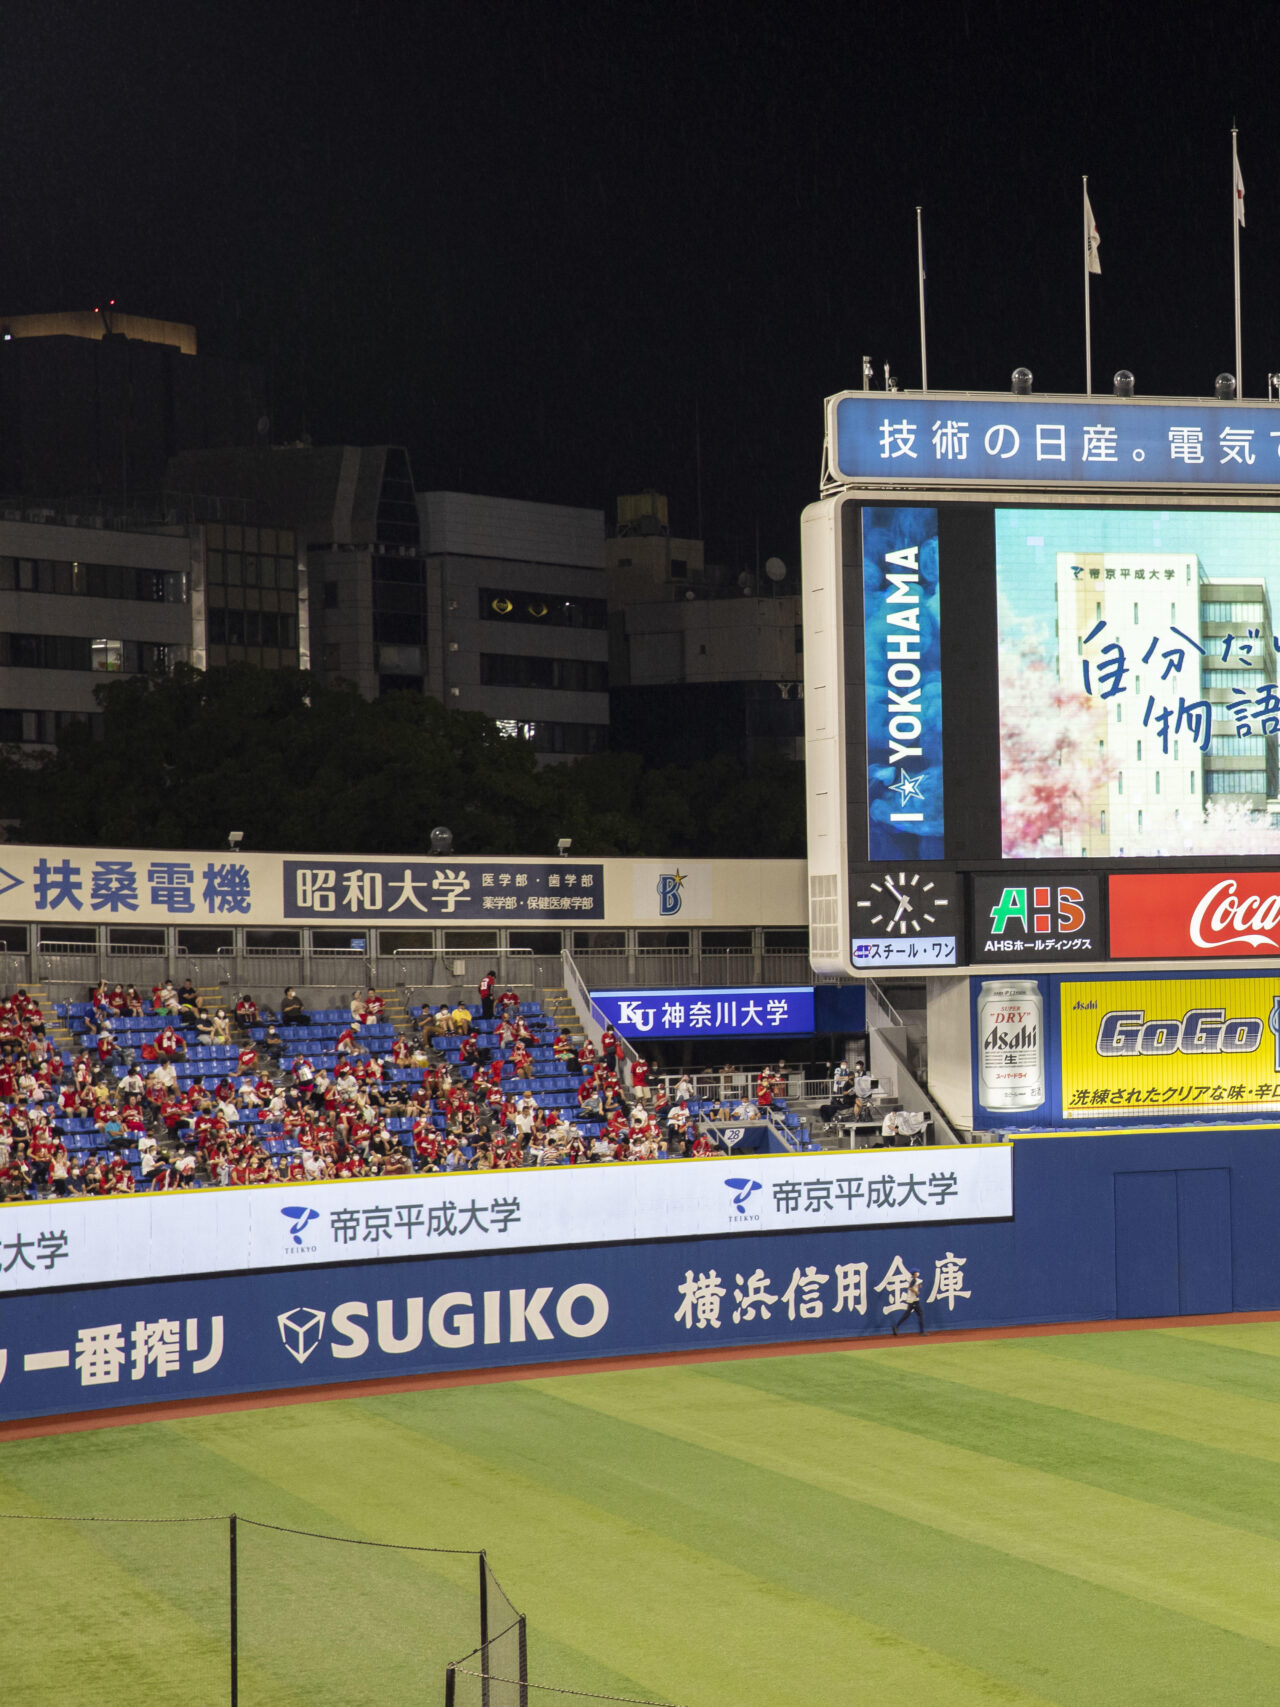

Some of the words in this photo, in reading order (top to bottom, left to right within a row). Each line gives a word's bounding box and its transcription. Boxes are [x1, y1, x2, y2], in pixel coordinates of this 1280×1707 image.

[1088, 568, 1176, 580] 帝京平成大学
[885, 545, 923, 764] YOKOHAMA
[889, 812, 924, 822] I
[33, 858, 252, 914] 扶桑電機
[296, 869, 471, 912] 昭和大学
[481, 873, 594, 887] 医学部・歯学部
[481, 896, 594, 910] 薬学部・保健医療学部
[989, 886, 1086, 934] AHS
[871, 941, 955, 960] スチール・ワン
[984, 938, 1092, 951] AHSホールディングス
[617, 1000, 657, 1032] KU
[661, 999, 789, 1029] 神奈川大学
[1072, 999, 1098, 1011] Asahi
[984, 1024, 1037, 1050] Asahi
[1095, 1008, 1264, 1057] GoGo
[1003, 1053, 1018, 1065] 生
[727, 1129, 741, 1140] 28
[772, 1171, 958, 1214] 帝京平成大学
[329, 1196, 522, 1245] 帝京平成大学
[728, 1214, 760, 1223] TEIKYO
[0, 1229, 69, 1273] 大学
[284, 1245, 318, 1255] TEIKYO
[673, 1251, 972, 1330] 横浜信用金庫
[331, 1282, 610, 1359] SUGIKO
[0, 1315, 224, 1387] 一番搾り
